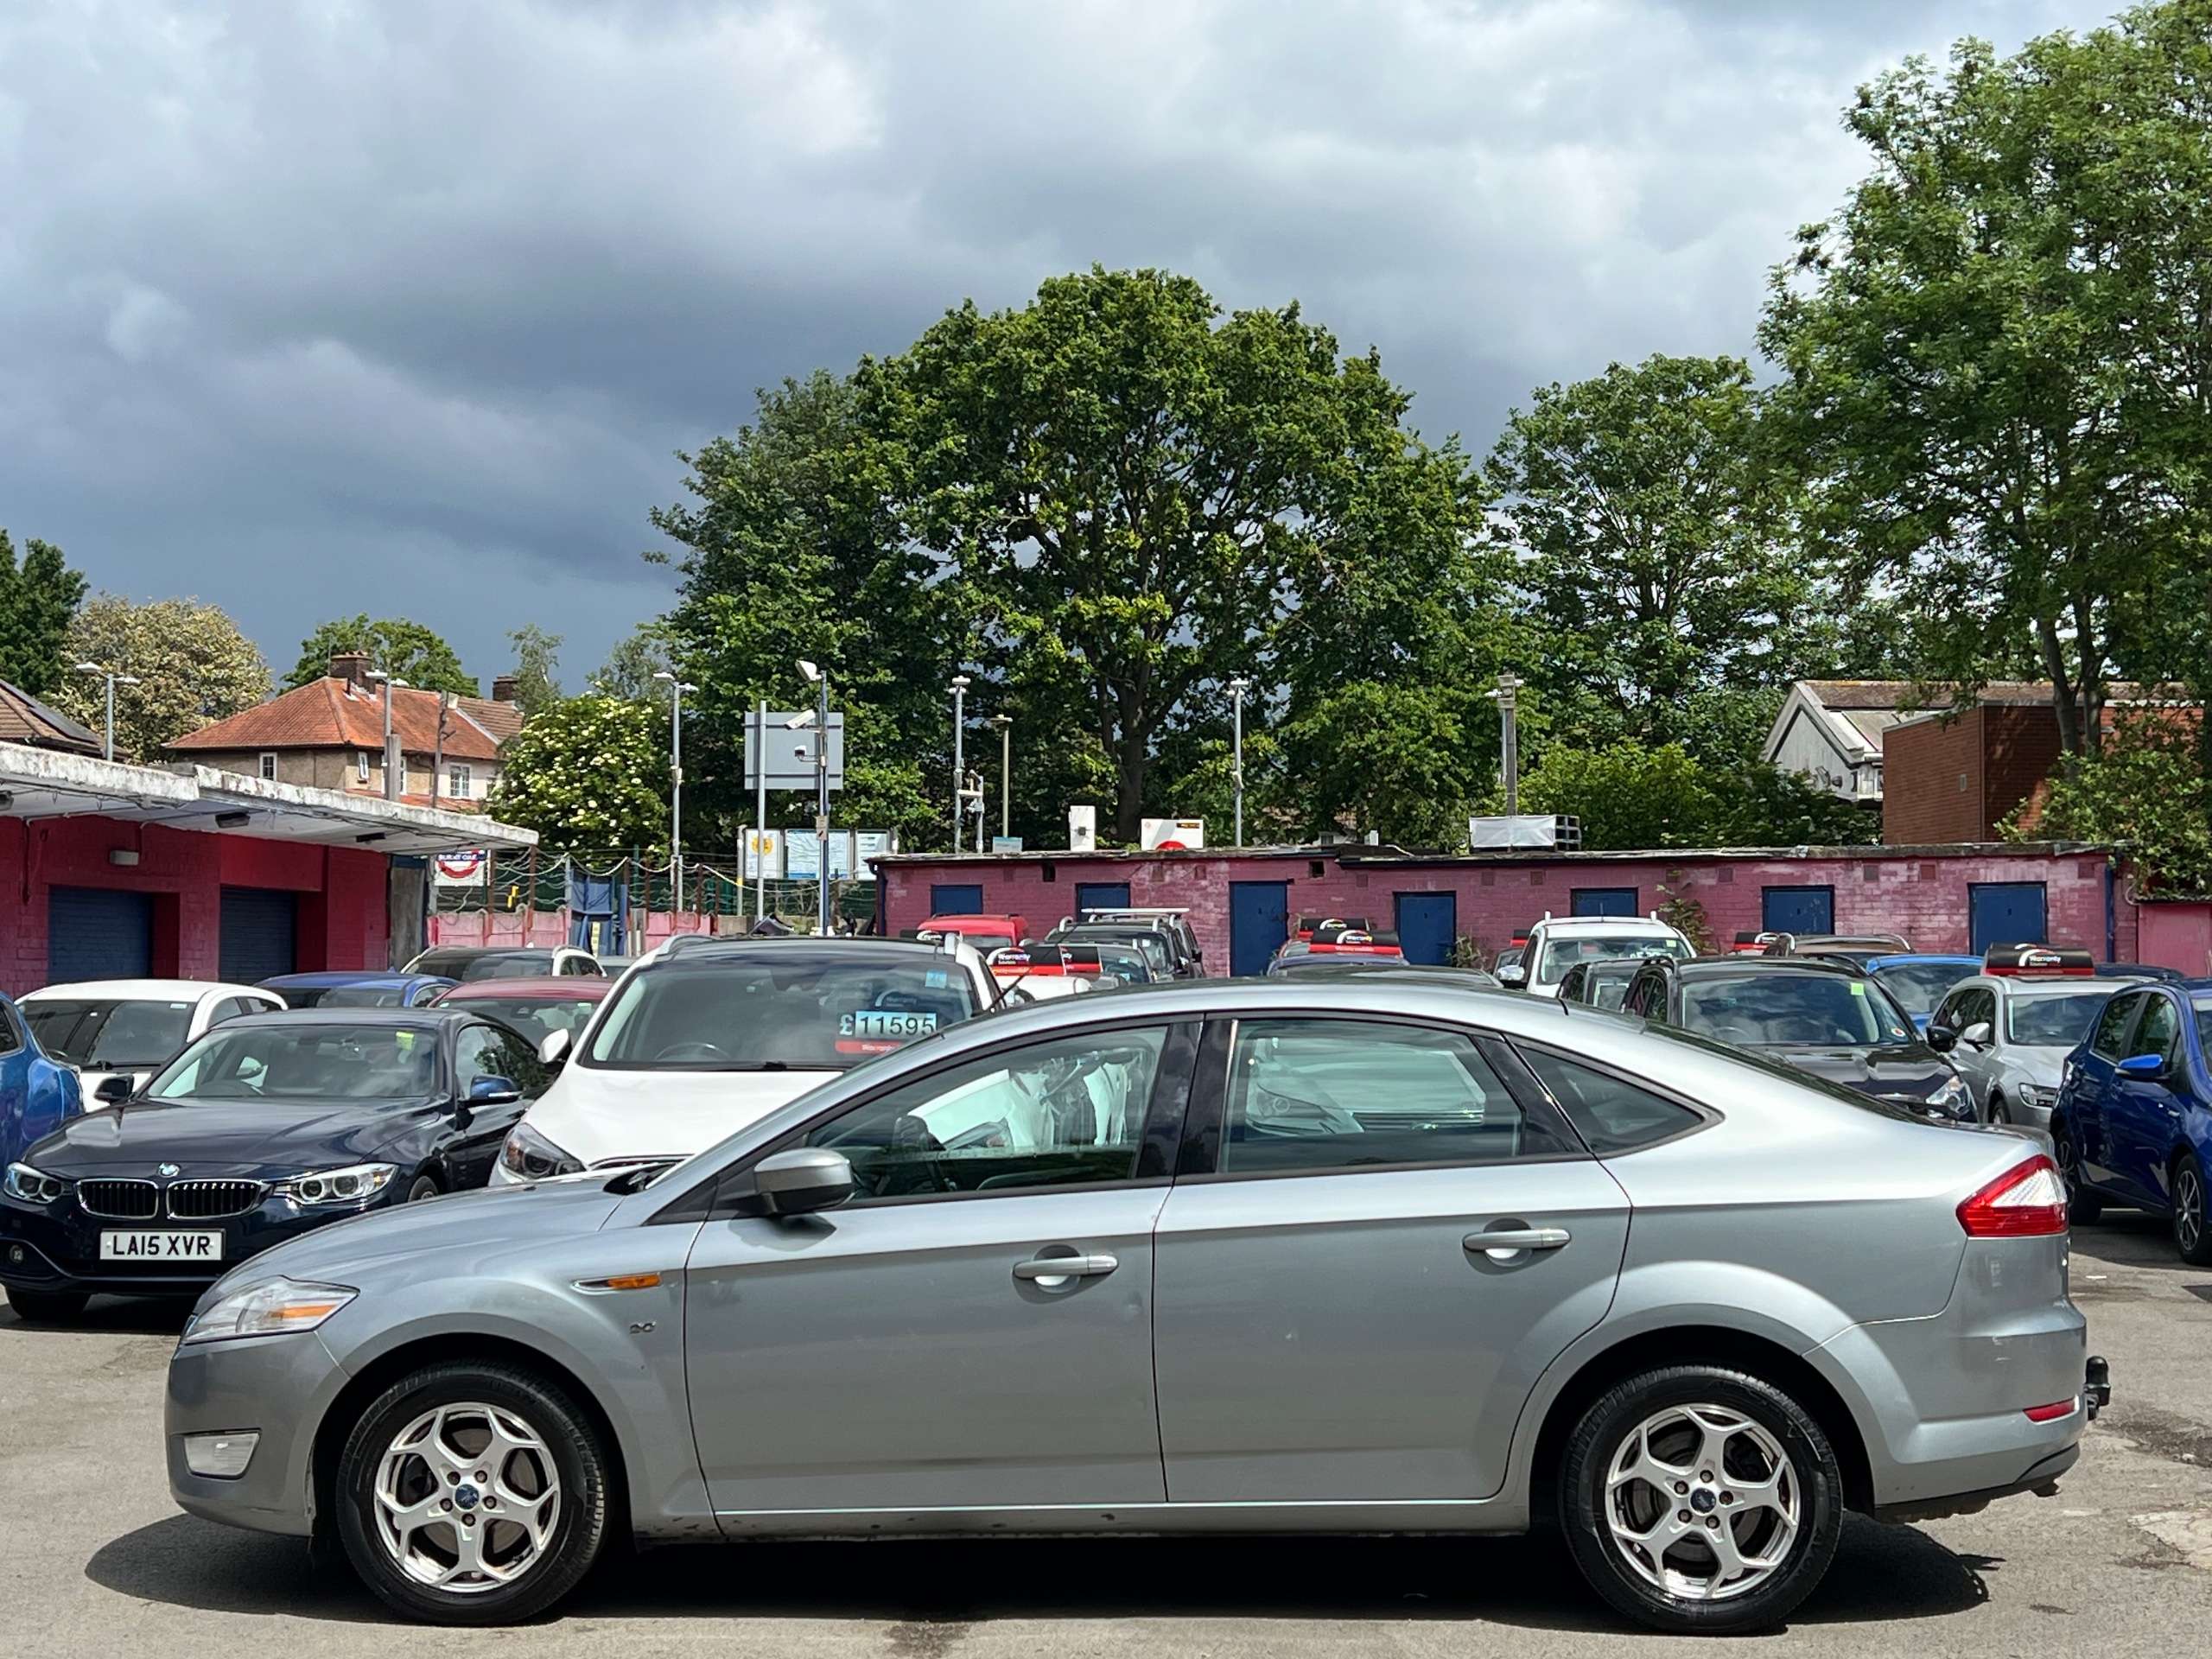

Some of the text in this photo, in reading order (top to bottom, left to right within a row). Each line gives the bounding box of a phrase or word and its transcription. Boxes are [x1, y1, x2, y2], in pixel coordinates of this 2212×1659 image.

[2030, 955, 2062, 963] Warranty
[839, 1014, 936, 1036] £11595
[112, 1235, 211, 1255] LA15 XVR
